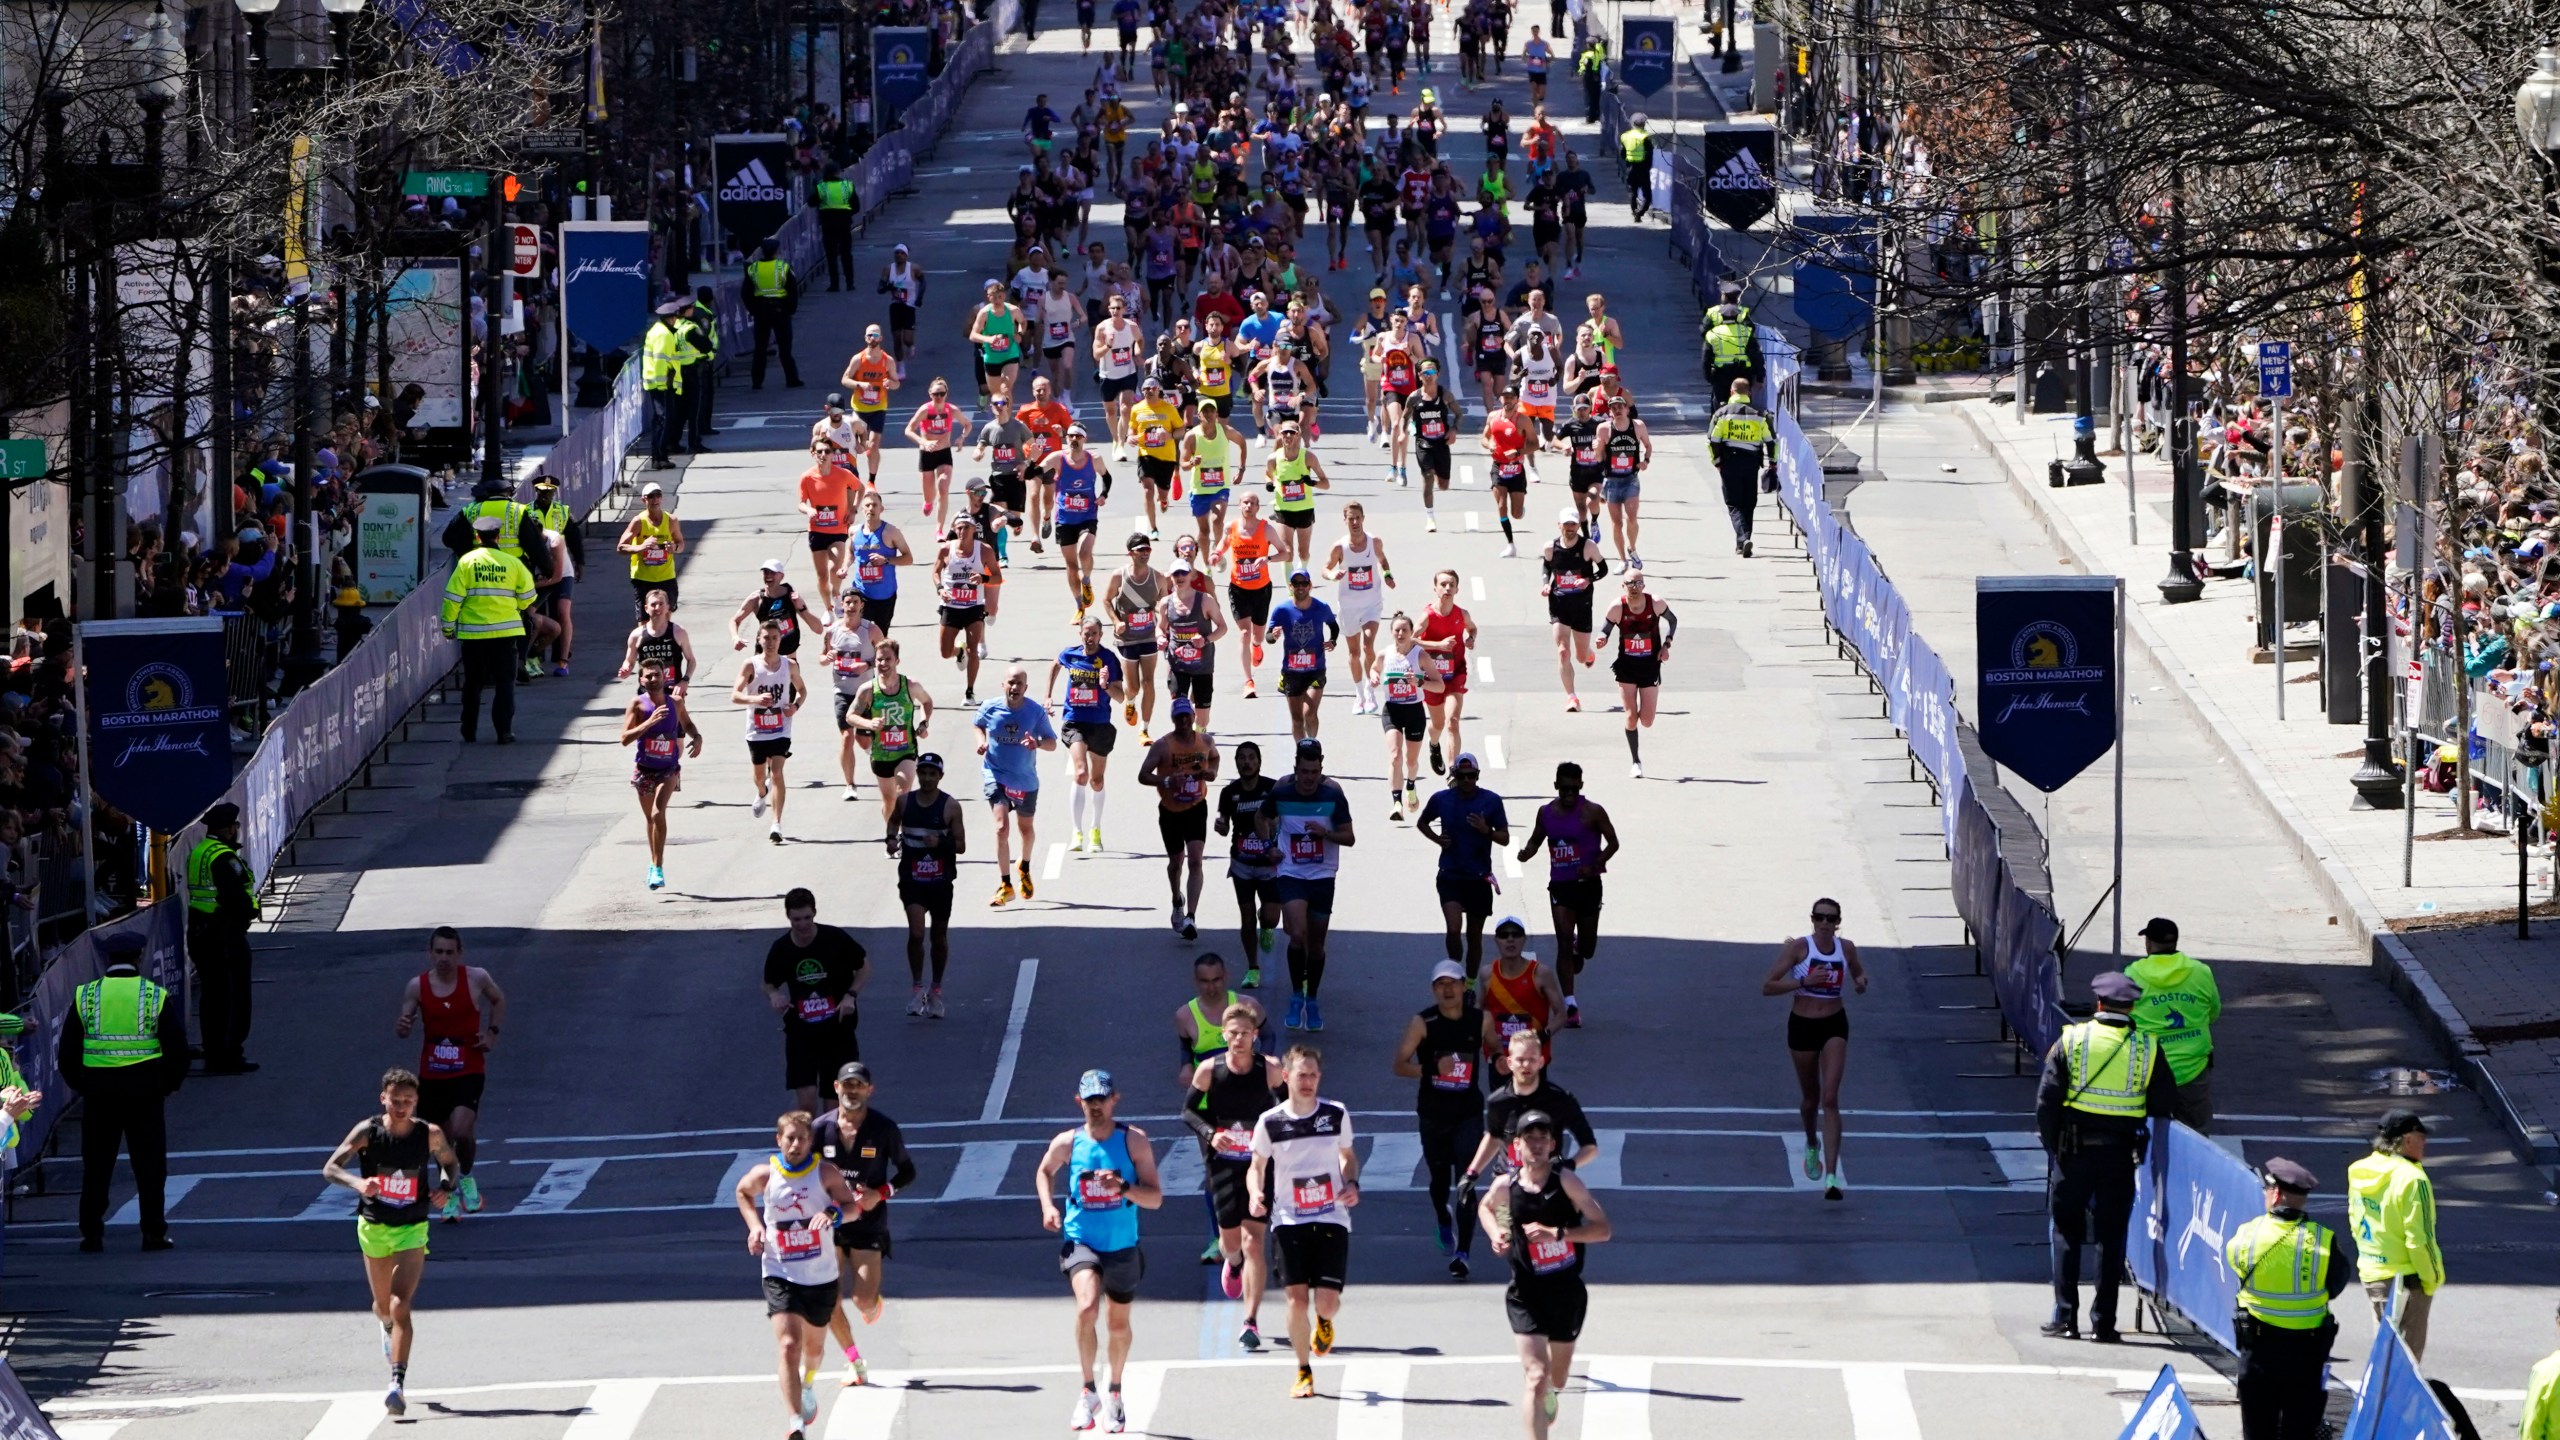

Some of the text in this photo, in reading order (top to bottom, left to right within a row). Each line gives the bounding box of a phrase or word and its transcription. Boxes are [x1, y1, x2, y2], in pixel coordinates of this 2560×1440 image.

[426, 176, 452, 194] RING
[454, 184, 463, 193] RD
[720, 185, 785, 201] adidas
[521, 236, 534, 245] NOT
[514, 256, 534, 265] NTER
[597, 256, 647, 280] Hancock
[2267, 345, 2280, 354] PAY
[2265, 366, 2285, 376] HERE
[14, 460, 27, 475] ST
[363, 522, 393, 533] DON'T
[363, 532, 403, 542] NATURE
[363, 540, 391, 550] GO TO
[362, 549, 401, 559] WASTE.
[473, 562, 507, 574] Boston
[474, 573, 507, 583] Police
[956, 589, 973, 599] 1171
[643, 644, 671, 652] GOOSE
[1631, 640, 1645, 650] 719
[1986, 668, 2104, 683] BOSTON MARATHON
[1995, 691, 2091, 724] John Hancock
[101, 708, 219, 727] BOSTON MARATHON
[113, 732, 210, 768] John Hancock
[917, 860, 939, 873] 2253
[2152, 991, 2197, 1007] BOSTON
[2156, 1029, 2202, 1045] OLUNTEER
[383, 1178, 411, 1195] 1923
[783, 1229, 812, 1248] 1595
